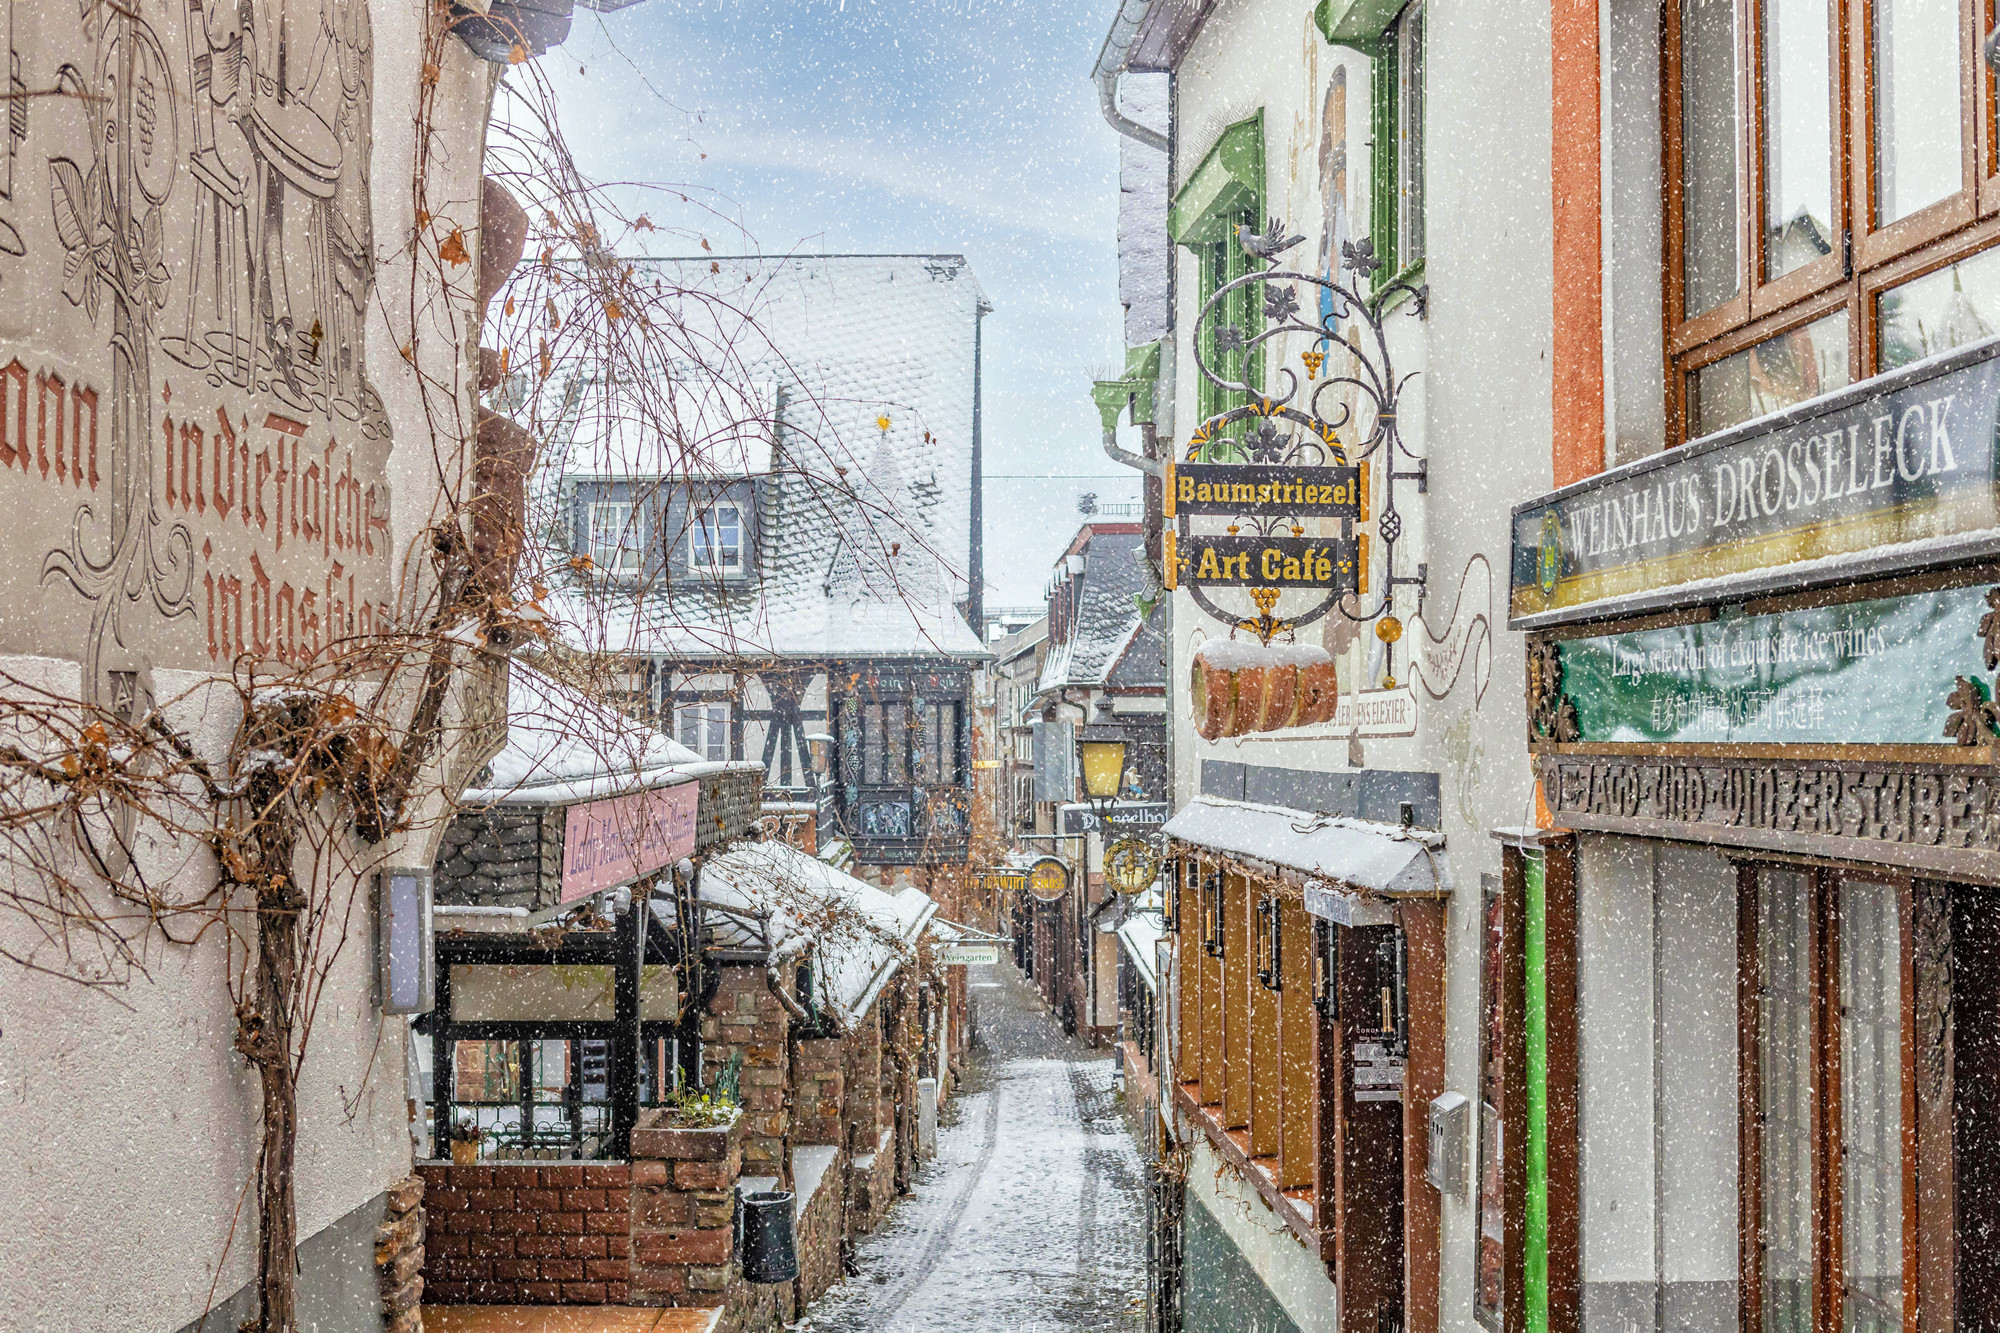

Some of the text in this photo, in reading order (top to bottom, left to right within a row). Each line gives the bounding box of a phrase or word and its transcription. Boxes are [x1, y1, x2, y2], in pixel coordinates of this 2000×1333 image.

[1178, 476, 1356, 505] Baumstriezel
[1568, 395, 1957, 560] WEINHAUS DROSSELECK
[1197, 548, 1331, 581] Art Café
[1612, 615, 1886, 687] Large selection of exquisite ice wines
